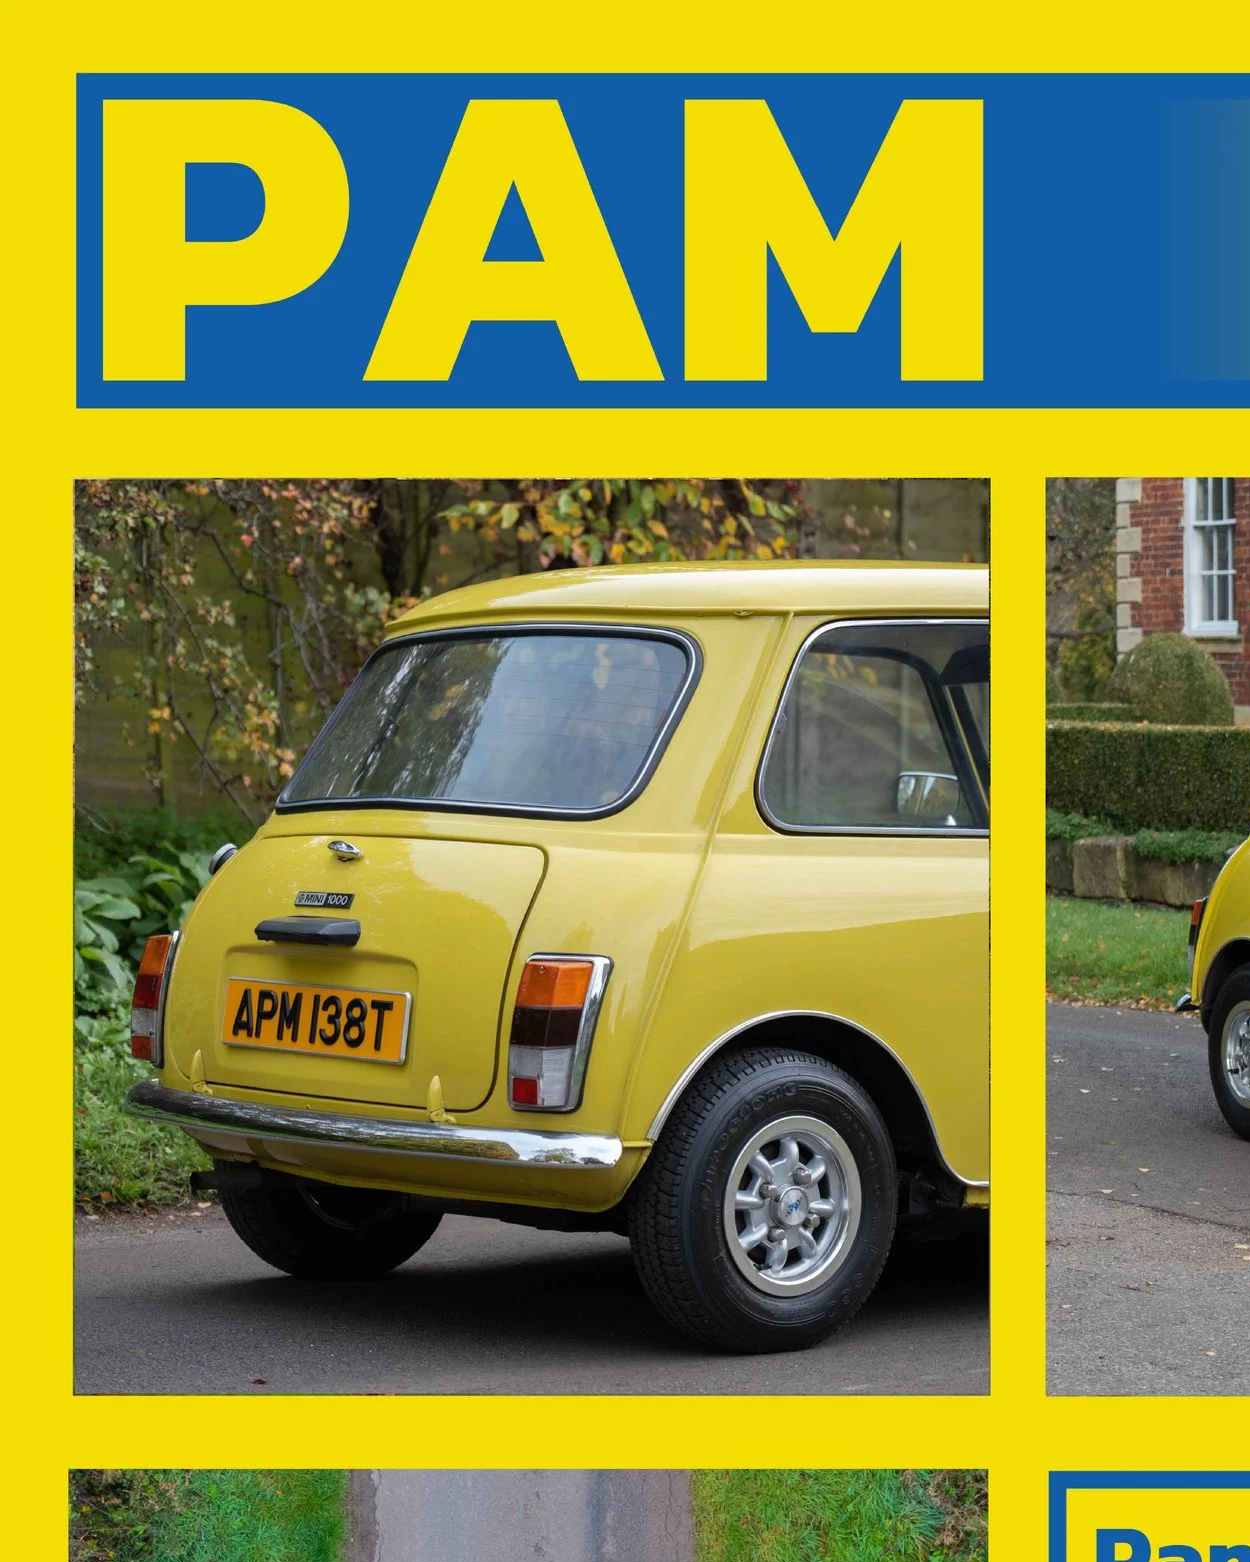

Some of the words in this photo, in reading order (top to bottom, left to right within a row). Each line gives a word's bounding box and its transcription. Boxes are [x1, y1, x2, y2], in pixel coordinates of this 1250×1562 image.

[102, 99, 984, 381] PAM
[304, 893, 325, 904] MINI
[326, 894, 349, 905] 1000
[232, 988, 303, 1042] APM
[308, 994, 394, 1051] 138T
